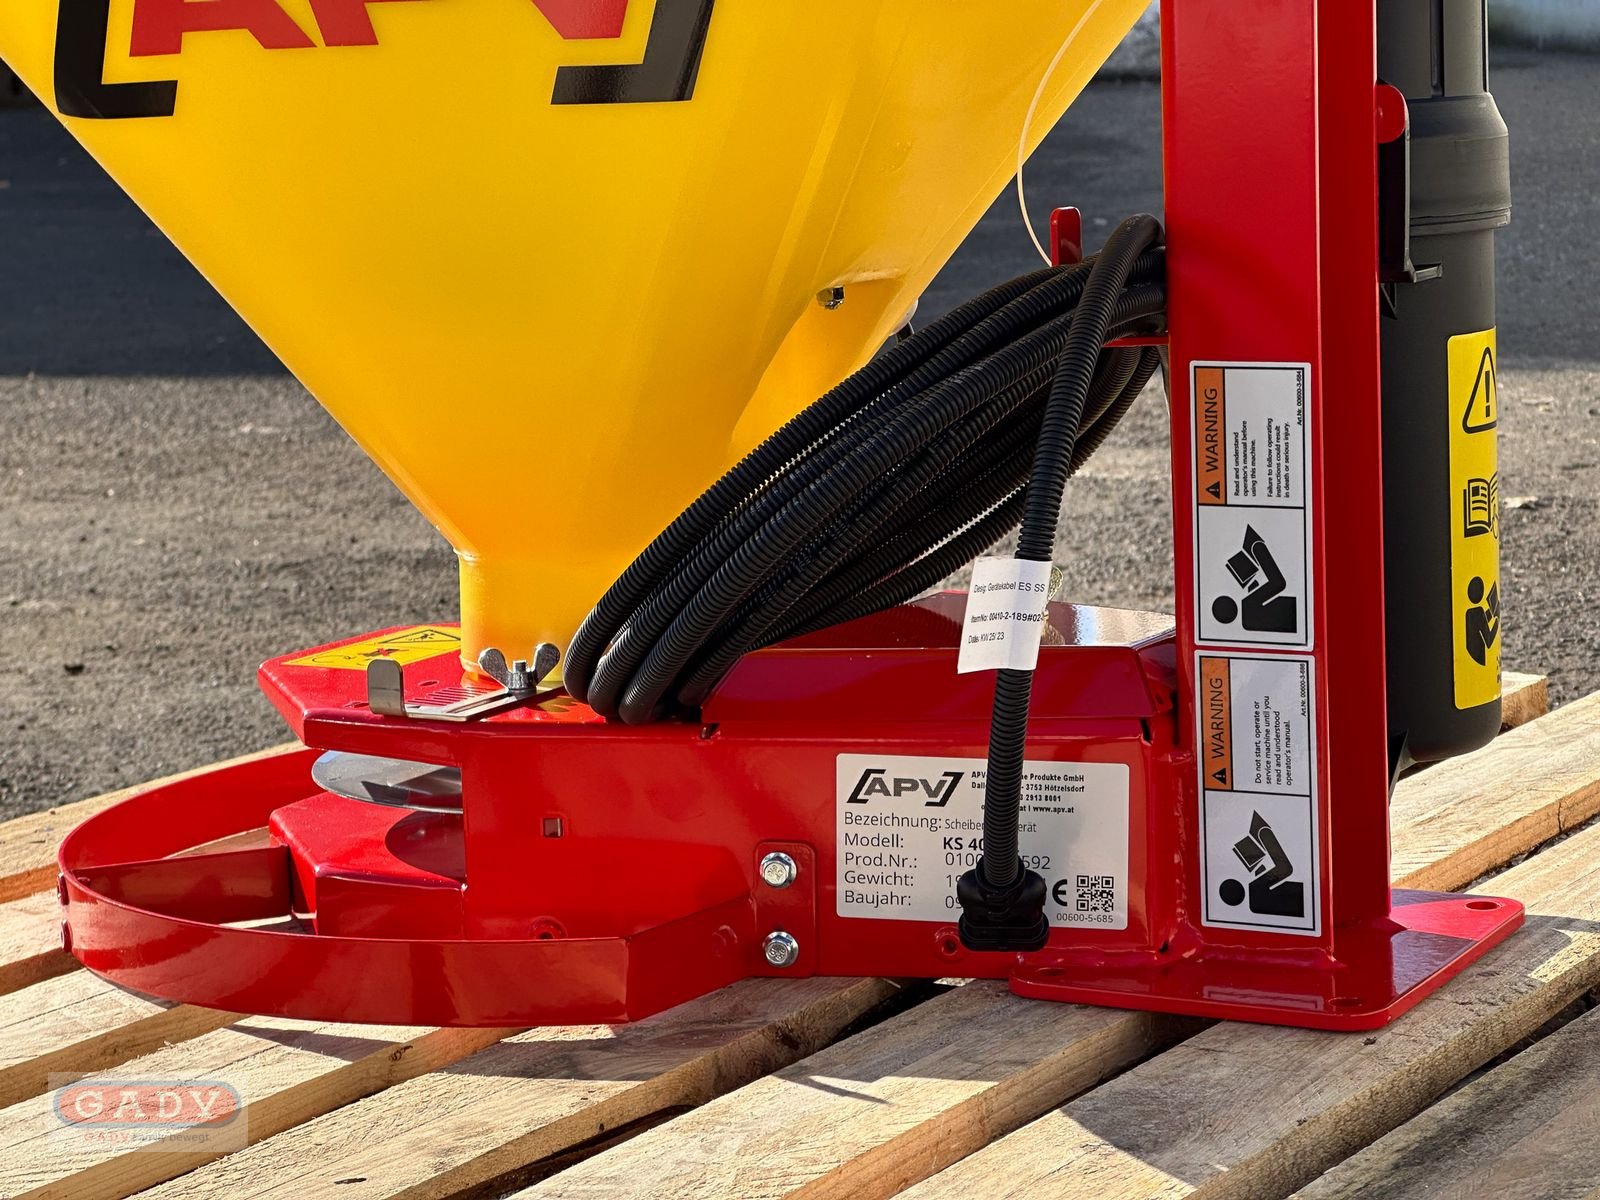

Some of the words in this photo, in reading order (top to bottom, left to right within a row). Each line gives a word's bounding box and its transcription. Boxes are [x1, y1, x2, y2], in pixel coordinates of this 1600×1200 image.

[1204, 388, 1218, 472] WARNING
[1267, 468, 1273, 476] to
[1284, 464, 1290, 472] or
[1018, 581, 1032, 592] ES
[1034, 583, 1046, 593] SS
[1253, 701, 1260, 710] or
[1210, 678, 1225, 760] WARNING
[1254, 710, 1262, 738] operate
[1273, 710, 1281, 752] understood
[1030, 773, 1061, 781] Produkte
[1063, 774, 1084, 782] GmbH
[1254, 773, 1262, 784] Do
[1264, 760, 1272, 785] service
[1033, 806, 1074, 814] www.apv.at
[844, 811, 942, 832] Bezeichnung:
[844, 832, 904, 848] Modell:
[943, 837, 963, 850] KS
[845, 852, 917, 868] Prod.Nr.:
[844, 870, 914, 887] Gewicht:
[845, 890, 911, 908] Baujahr:
[1056, 912, 1114, 923] 00600-5-685
